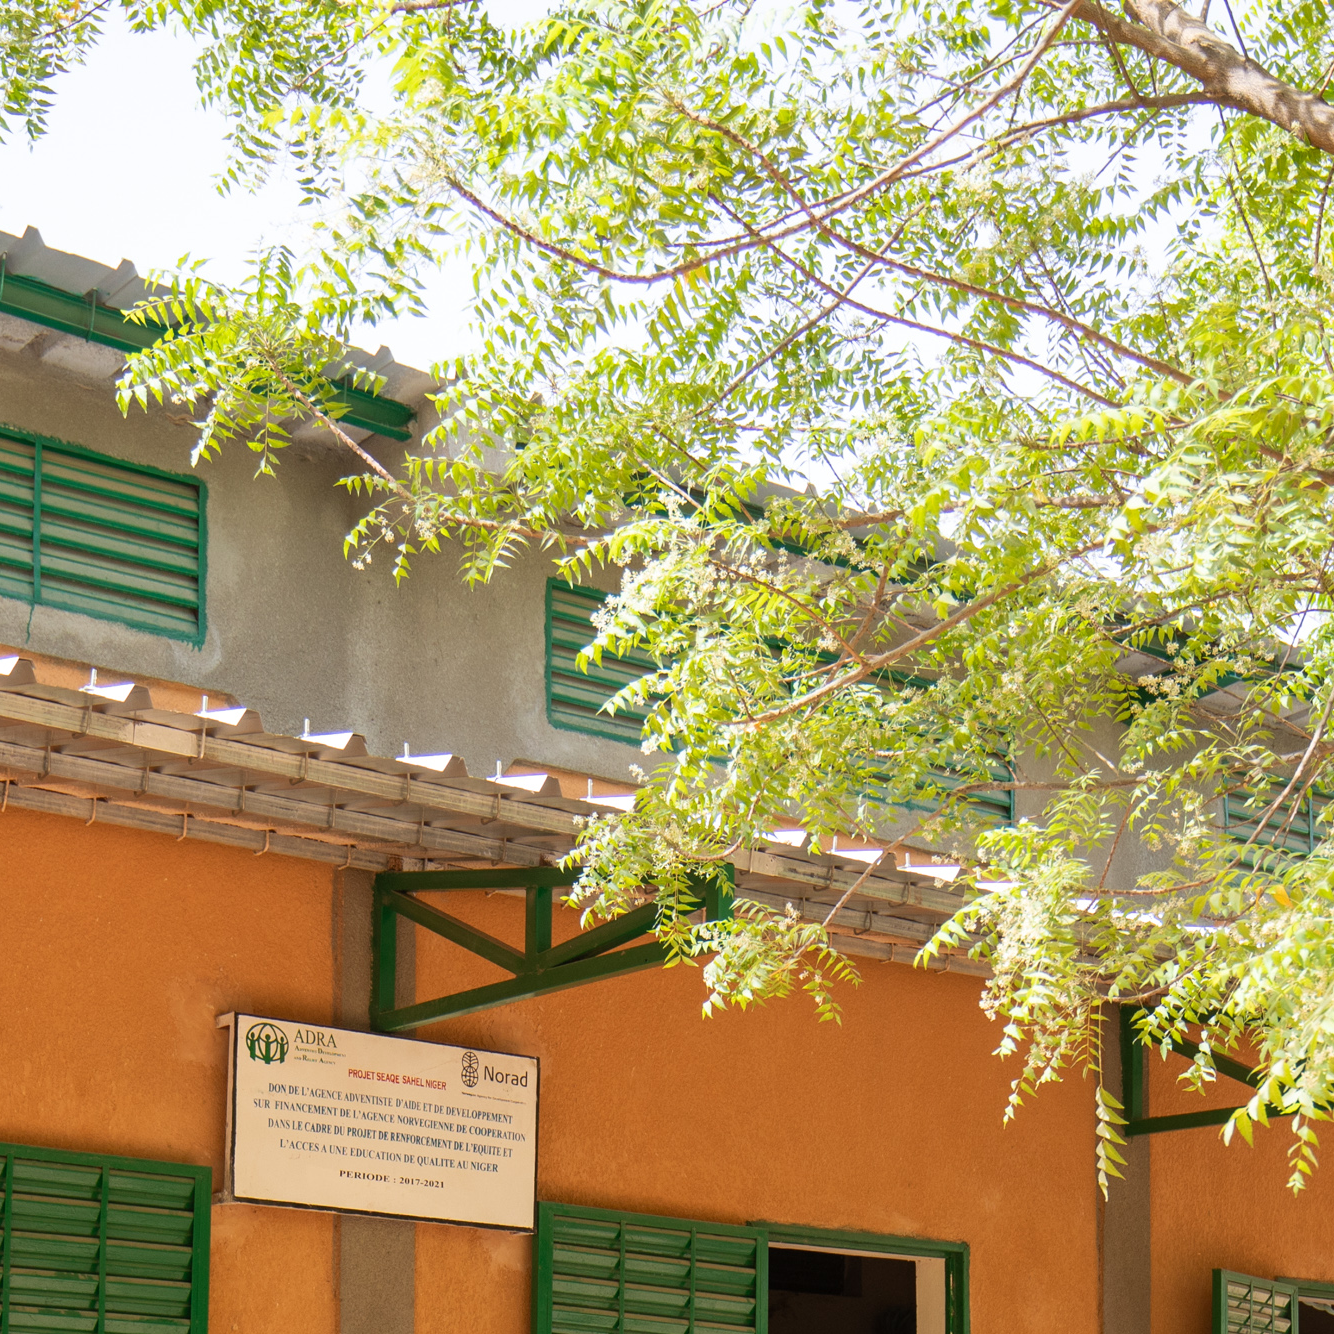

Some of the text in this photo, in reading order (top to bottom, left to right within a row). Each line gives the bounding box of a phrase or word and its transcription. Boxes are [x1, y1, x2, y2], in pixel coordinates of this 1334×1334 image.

[294, 1029, 337, 1048] ADRA
[348, 1068, 446, 1090] PROJET SEAQE SAHEL NIGER
[484, 1066, 528, 1087] Norad
[268, 1082, 513, 1124] DON DE L'AGENCE ADVENTISTE D'AIDE ET DE DEVELOPPEMENT
[253, 1098, 526, 1142] SUR FINANCEMENT DE L'AGENCE NORVEGIENNE DE COOPERATION
[268, 1118, 290, 1130] DANS
[292, 1120, 302, 1131] LE
[304, 1122, 332, 1135] CADRE
[334, 1126, 345, 1136] DU
[347, 1127, 377, 1141] PROJET
[378, 1131, 389, 1141] DE
[454, 1142, 464, 1151] DE
[466, 1142, 502, 1156] L'EQUITE
[503, 1148, 513, 1158] ET
[280, 1139, 499, 1172] L'ACCES A UNE EDUCATION DE QUALITE AU NIGER
[339, 1170, 390, 1182] PERIODE
[399, 1177, 445, 1188] 2017-2021
